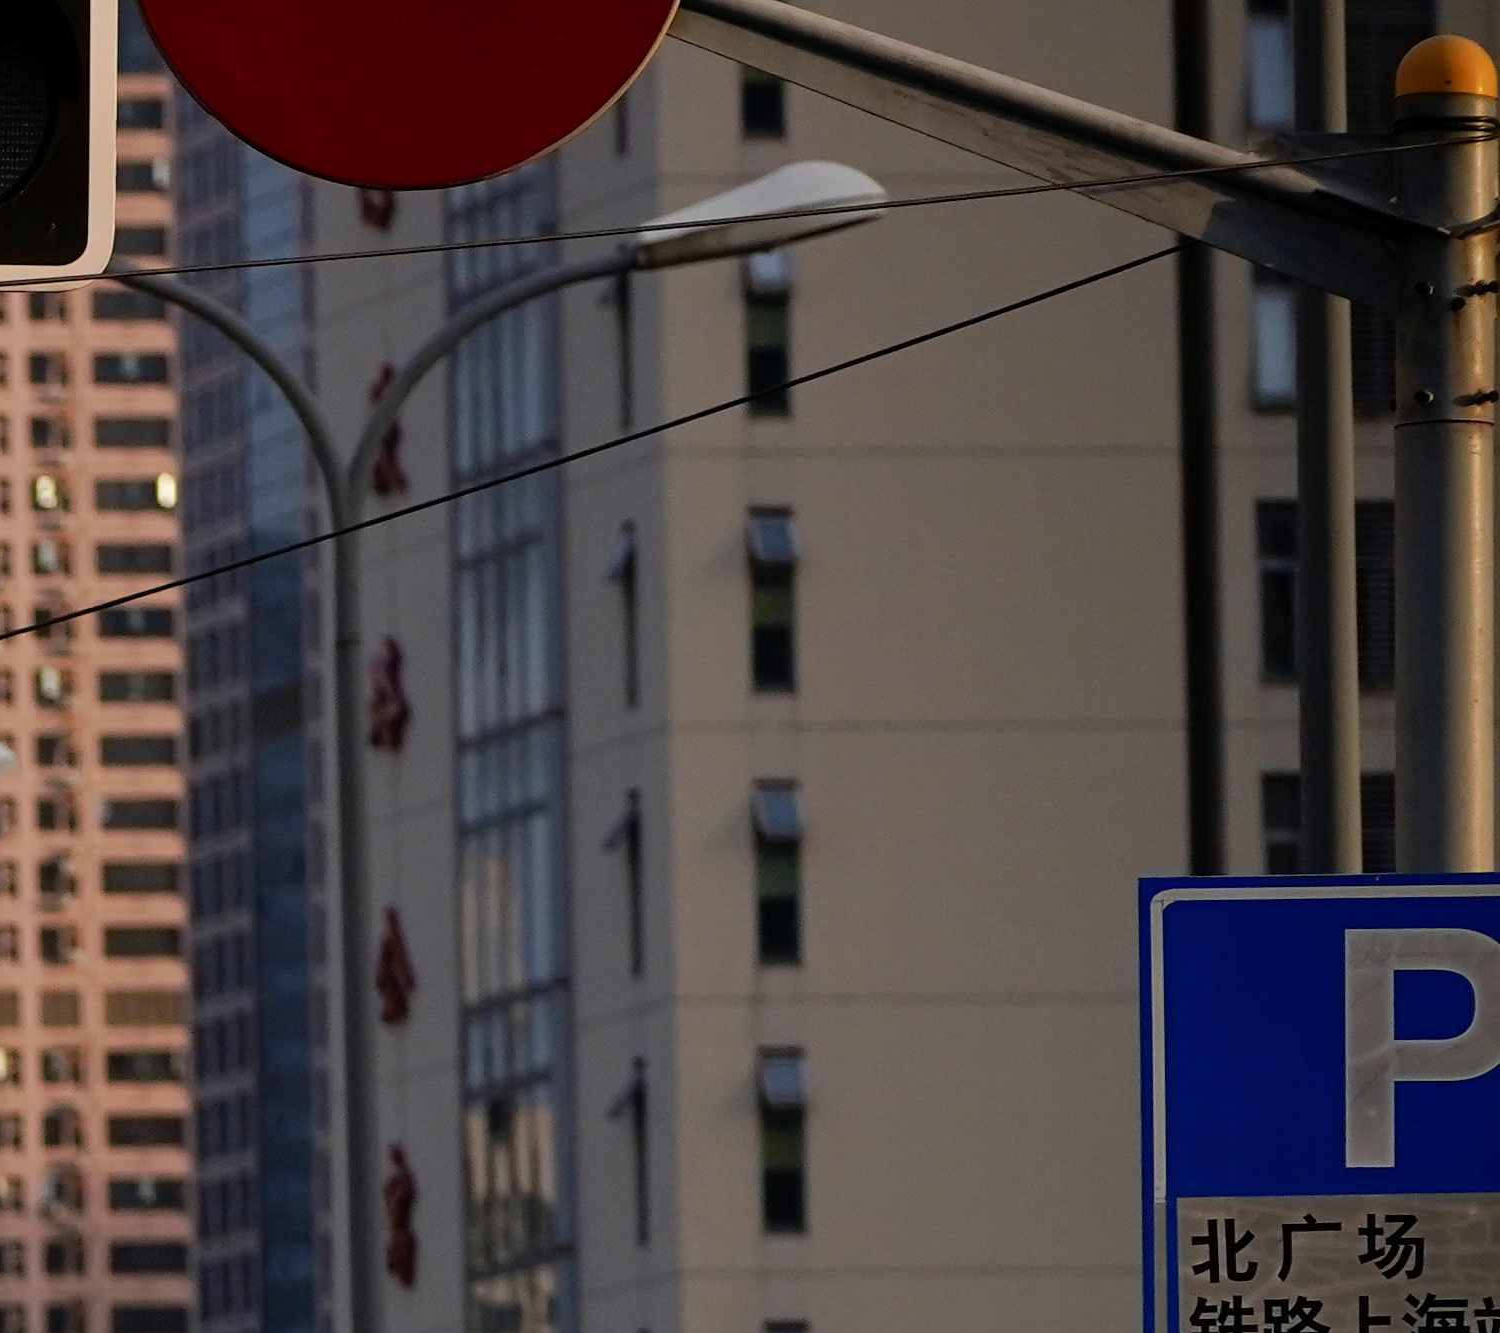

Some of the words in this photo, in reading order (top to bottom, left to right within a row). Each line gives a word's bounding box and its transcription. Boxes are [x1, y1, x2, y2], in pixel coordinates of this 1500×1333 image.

[1345, 928, 1500, 1168] P
[1191, 1214, 1426, 1283] 北广场
